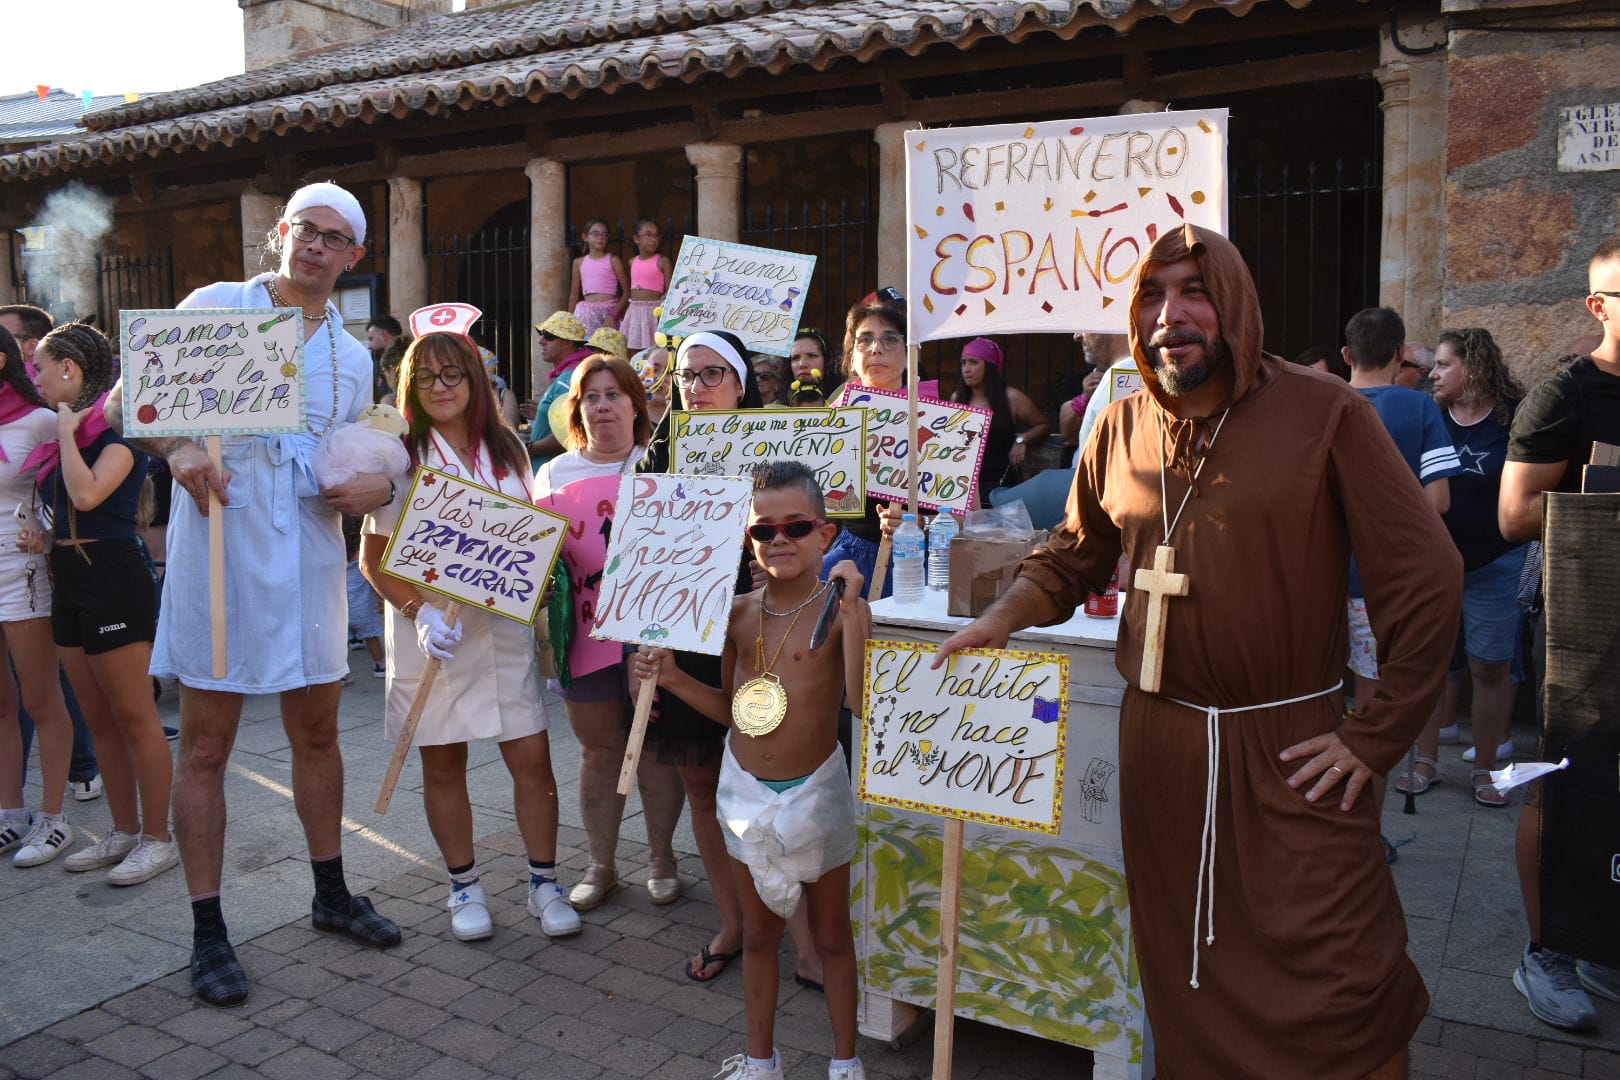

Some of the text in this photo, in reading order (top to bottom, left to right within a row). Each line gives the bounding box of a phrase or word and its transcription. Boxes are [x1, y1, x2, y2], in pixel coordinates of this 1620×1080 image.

[1563, 105, 1620, 121] IGLE
[934, 126, 1190, 194] REFRANERO
[1594, 134, 1618, 148] DE
[683, 243, 798, 288] A buenas
[930, 205, 1158, 296] ESPAÑO
[706, 272, 775, 305] horas
[723, 304, 795, 344] VERDES
[175, 341, 280, 367] pocos y
[237, 359, 268, 384] la
[157, 383, 291, 421] ABUELA
[931, 409, 971, 432] el
[676, 409, 851, 441] Para lo que me queda
[685, 430, 855, 463] en el CONVENTO
[917, 442, 970, 466] por
[413, 481, 535, 547] Mas vale
[407, 519, 536, 577] PREVENIR
[626, 537, 730, 578] pero
[394, 545, 438, 567] que
[444, 563, 534, 603] CURAR
[873, 650, 1051, 701] El hábito
[900, 703, 1029, 746] no hace
[872, 741, 1057, 805] al MONJE
